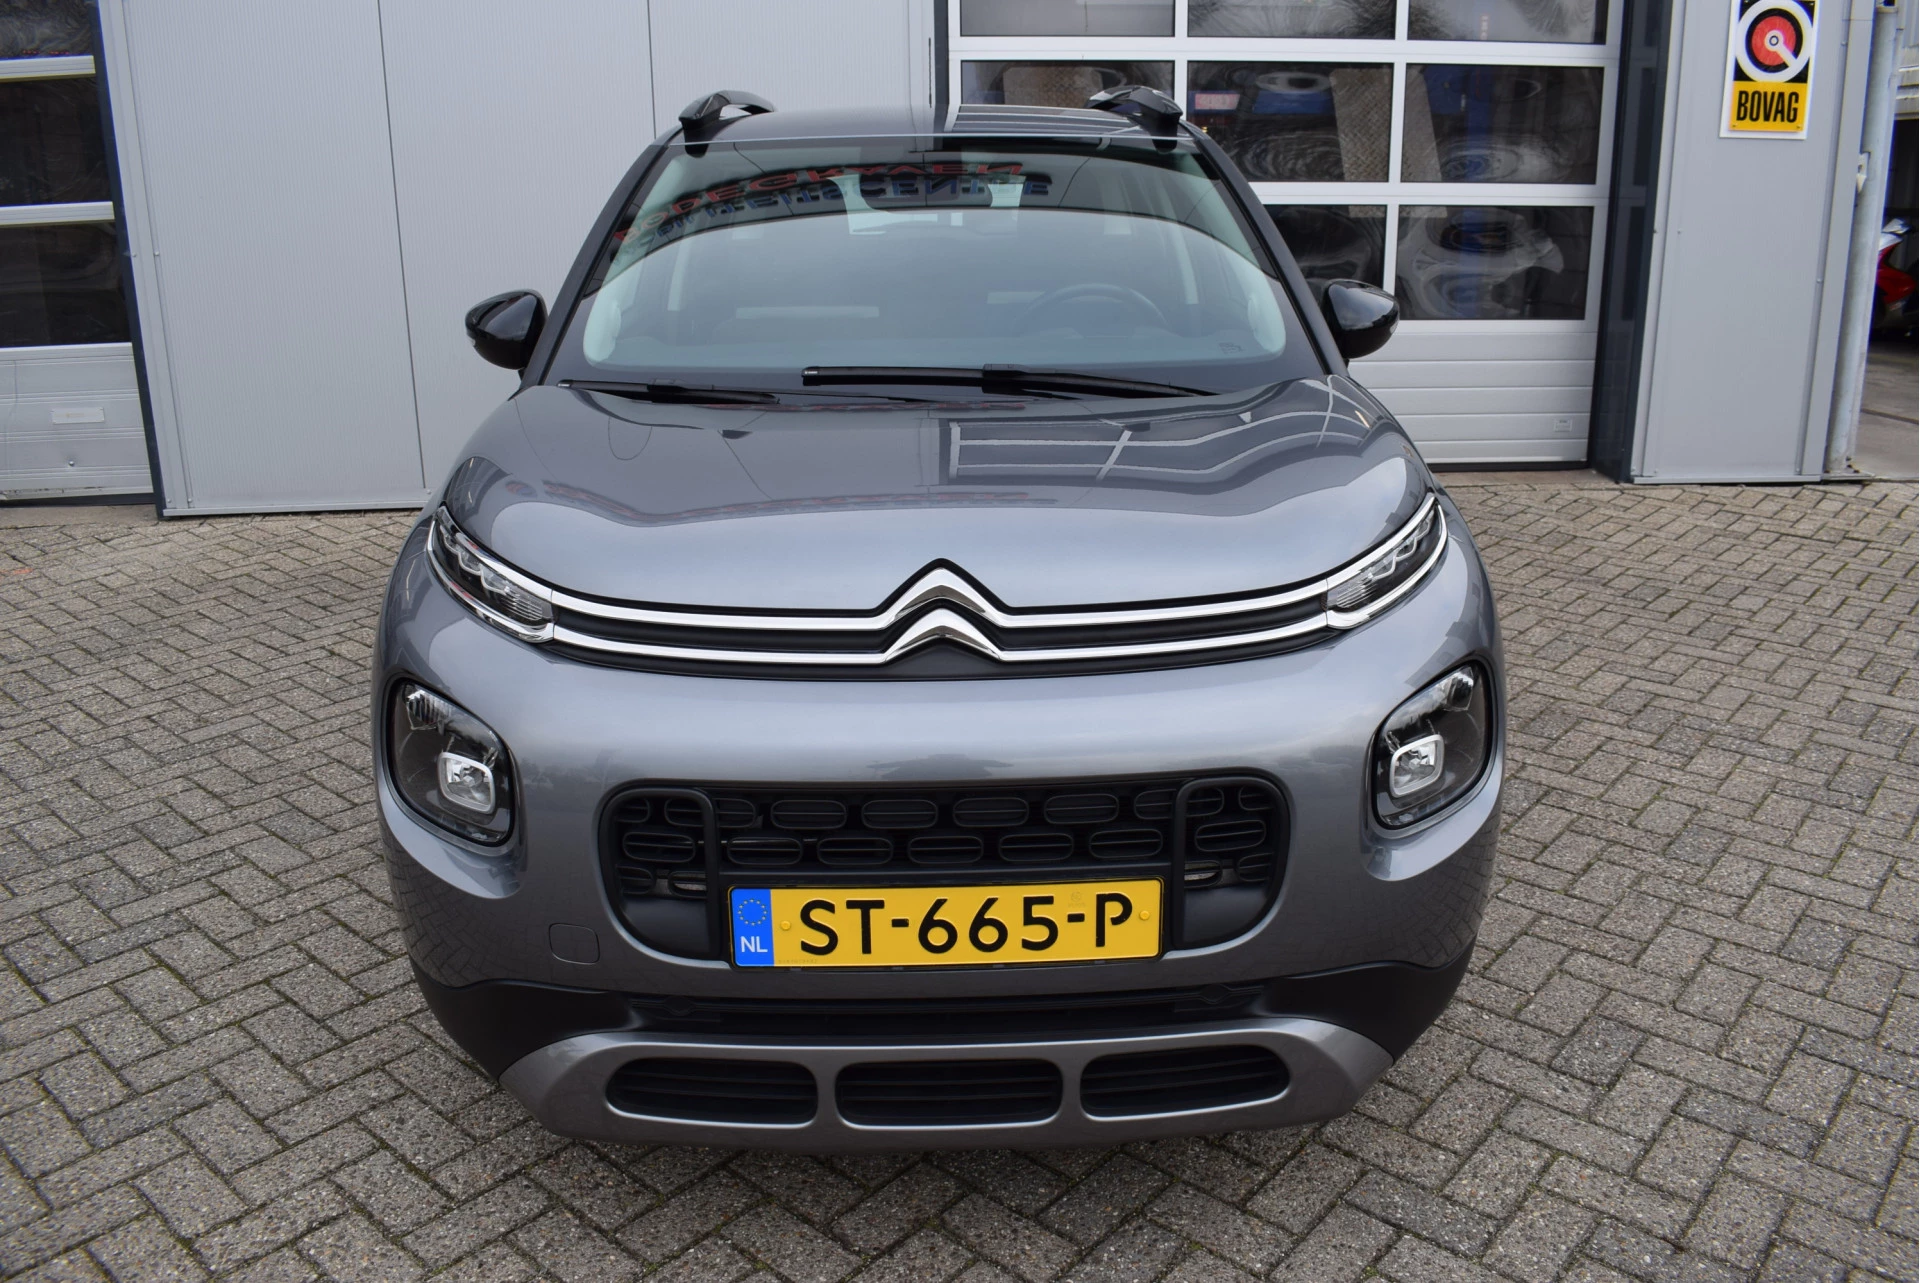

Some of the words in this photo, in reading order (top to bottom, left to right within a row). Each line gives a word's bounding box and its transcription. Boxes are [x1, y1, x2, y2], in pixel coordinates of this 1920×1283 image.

[1736, 90, 1800, 123] BOVAG
[800, 893, 1133, 955] ST-665-P
[740, 936, 768, 953] NL
